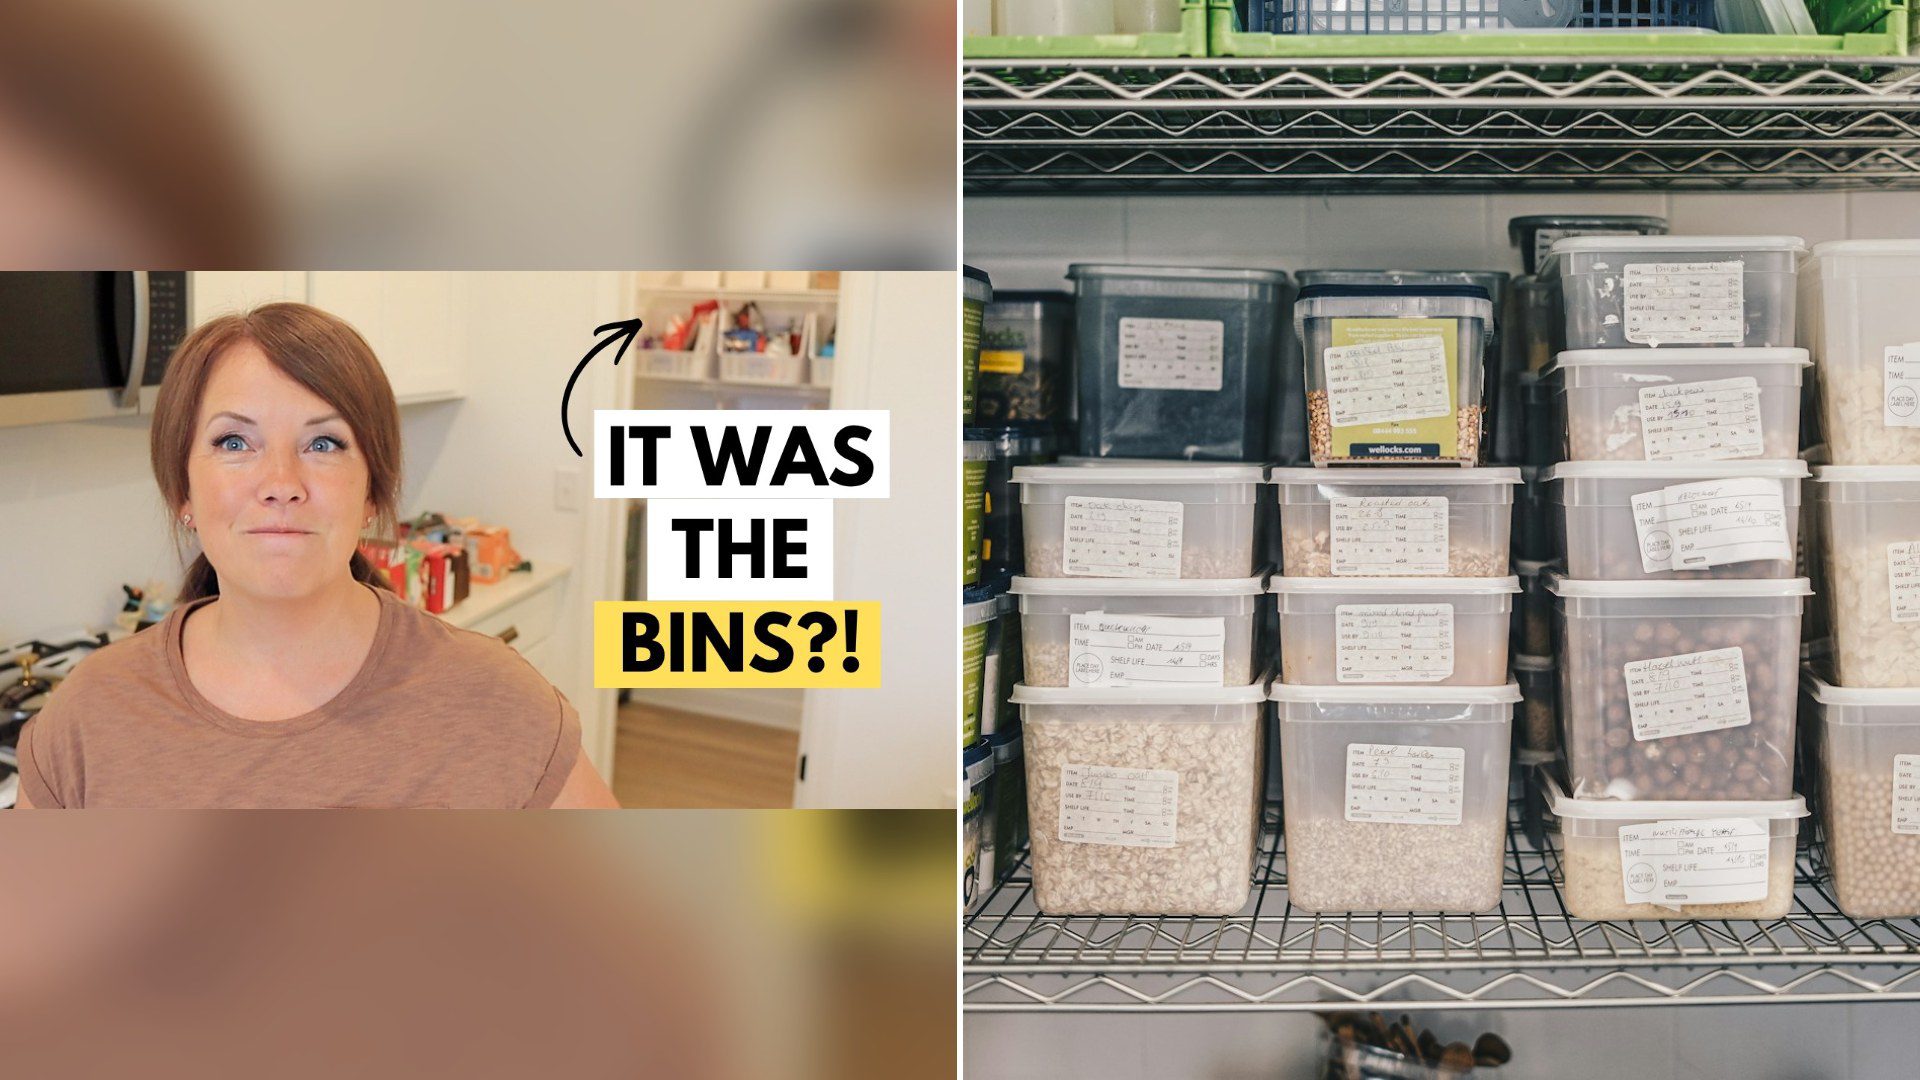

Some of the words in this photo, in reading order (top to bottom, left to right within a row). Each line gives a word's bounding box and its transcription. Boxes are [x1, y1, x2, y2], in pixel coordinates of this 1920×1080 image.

[1888, 355, 1904, 363] ITEM
[1889, 371, 1904, 379] TIME
[1369, 446, 1421, 454] wellocks.com
[1711, 507, 1728, 516] DATE
[1679, 526, 1697, 536] SHELF
[1700, 525, 1712, 533] LIFE
[1074, 623, 1090, 631] ITEM
[1111, 656, 1130, 665] SHELF
[1697, 847, 1715, 855] DATE
[1663, 864, 1682, 872] SHELF
[1684, 863, 1698, 871] LIFE
